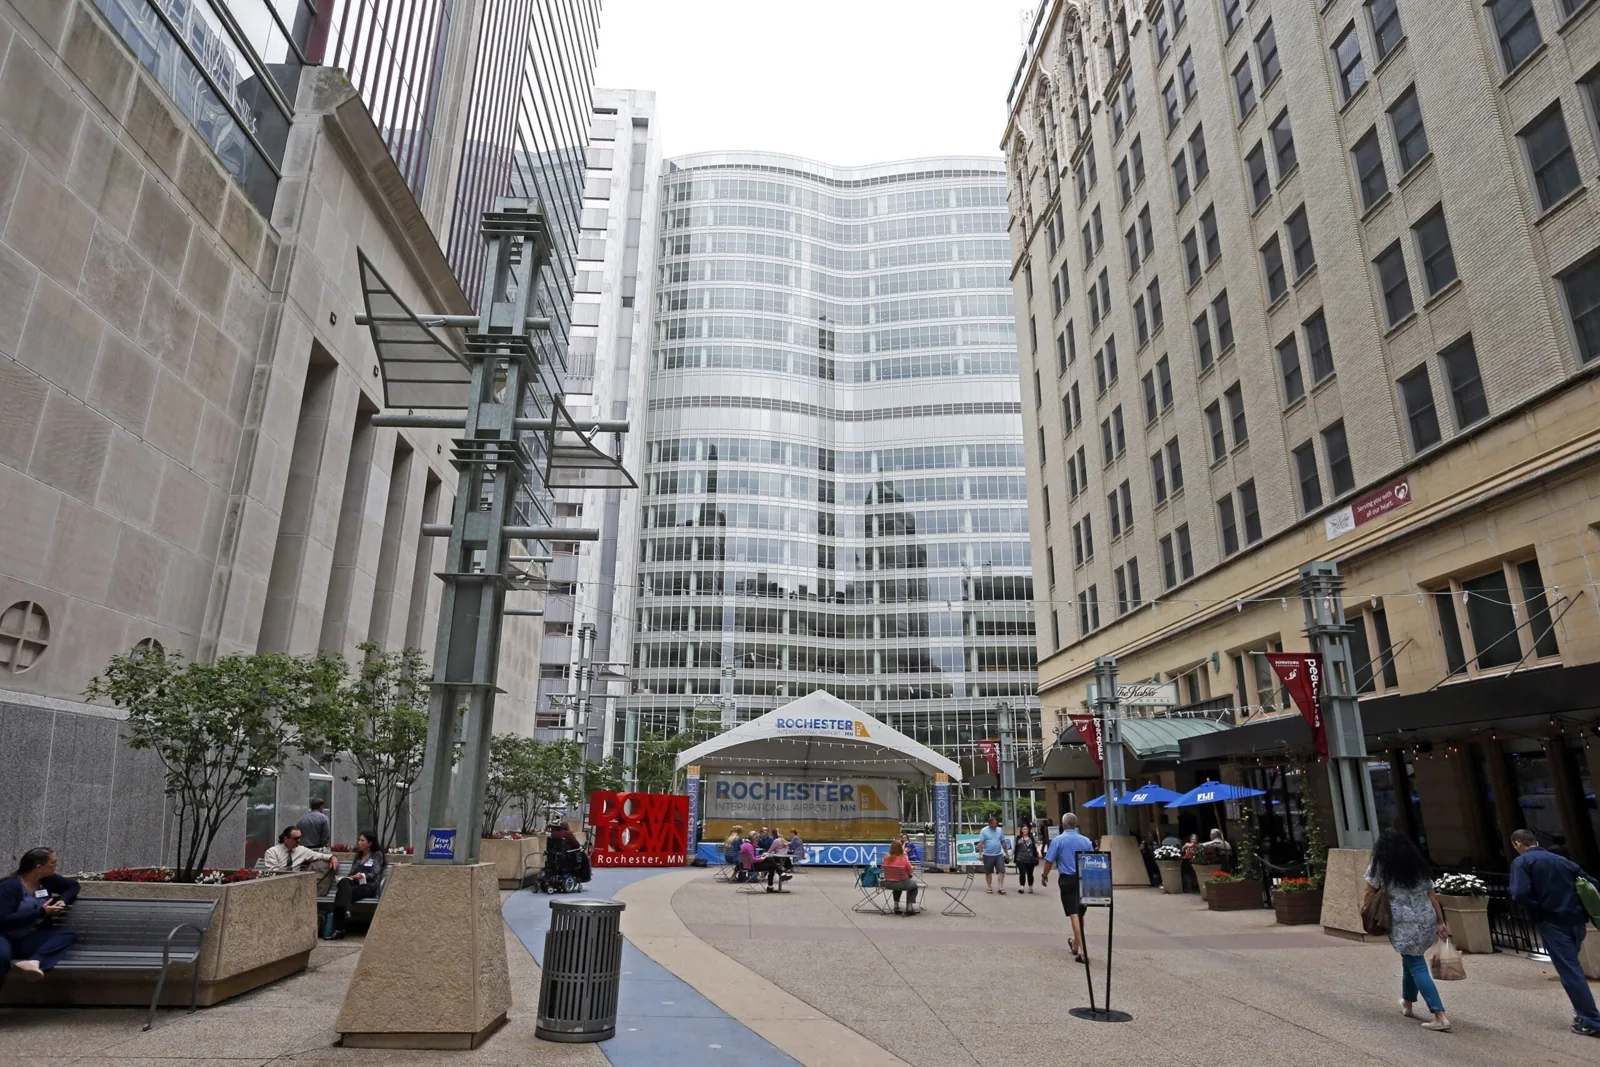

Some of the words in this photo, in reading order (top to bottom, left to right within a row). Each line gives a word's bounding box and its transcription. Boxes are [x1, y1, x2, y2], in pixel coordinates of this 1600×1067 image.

[1357, 500, 1373, 513] Serving
[1373, 496, 1382, 507] you
[1382, 490, 1392, 501] with
[1372, 506, 1380, 515] our
[1118, 686, 1129, 697] The
[776, 718, 853, 731] ROCHESTER
[715, 780, 855, 802] ROCHESTER
[590, 792, 690, 823] DOWN
[715, 802, 791, 812] INTERNATIONAL
[793, 803, 834, 813] AIRPORT
[840, 804, 856, 812] MN
[861, 792, 869, 809] RST
[938, 790, 947, 860] FLYRST.COM
[596, 822, 689, 852] TOWN
[597, 854, 663, 865] Rochester,
[667, 854, 684, 863] MN
